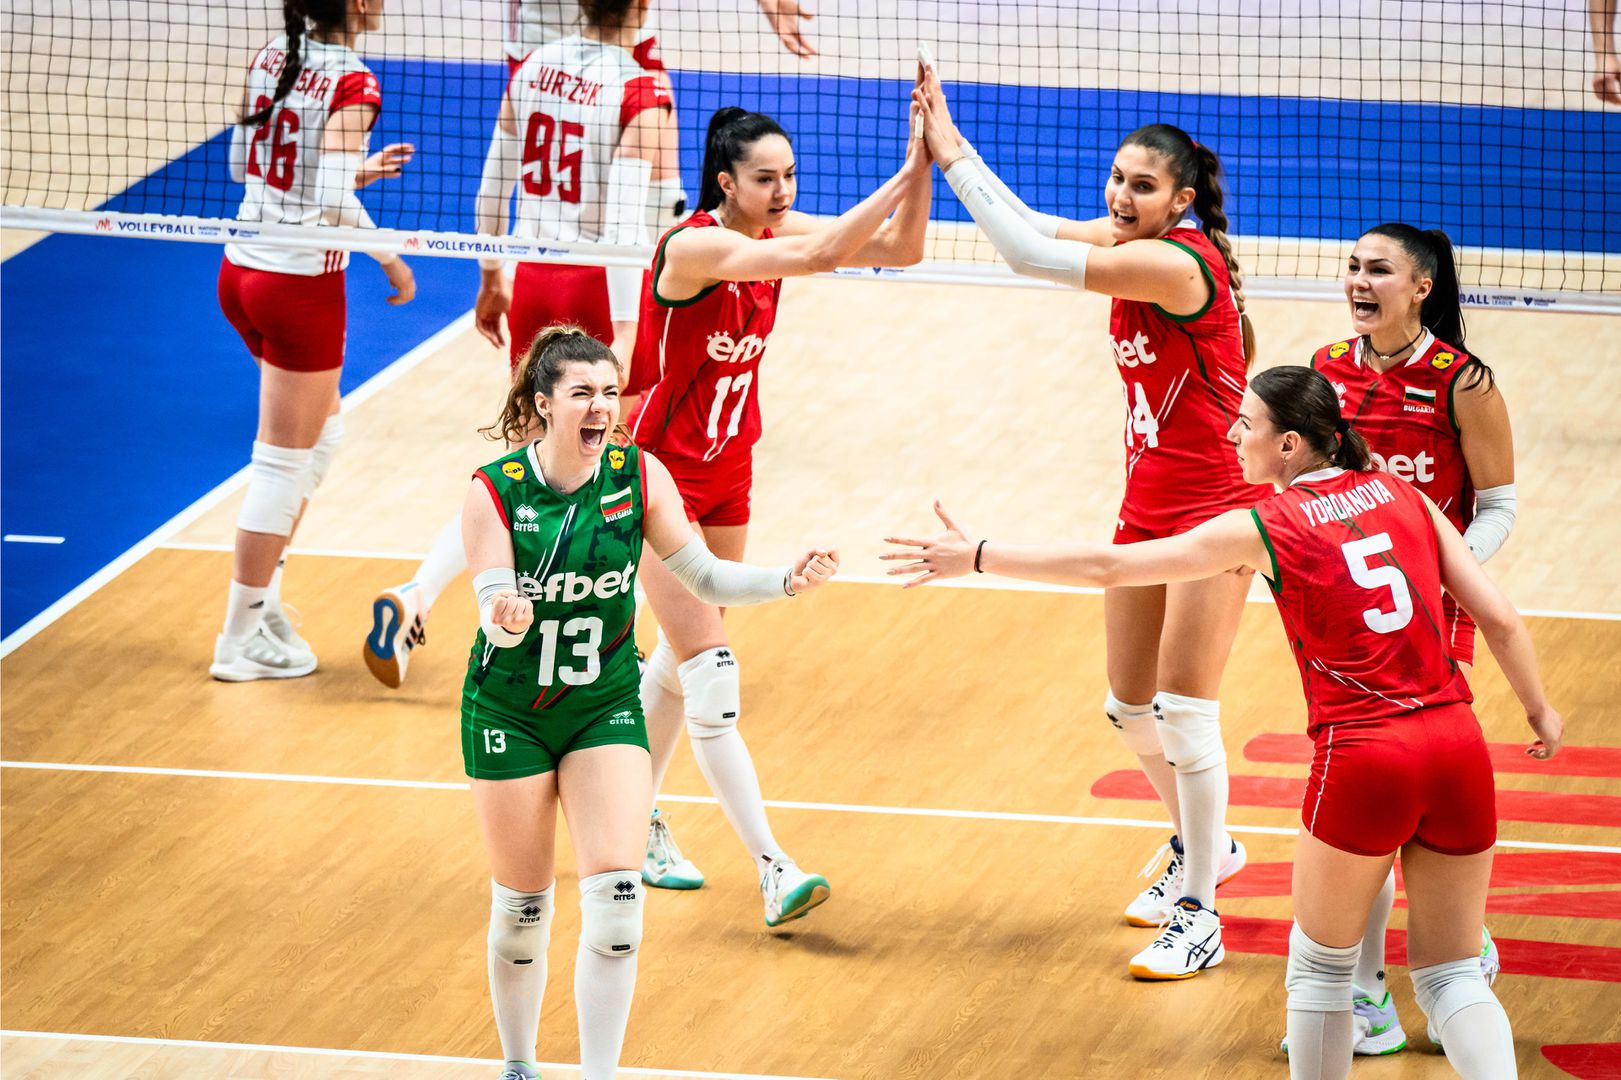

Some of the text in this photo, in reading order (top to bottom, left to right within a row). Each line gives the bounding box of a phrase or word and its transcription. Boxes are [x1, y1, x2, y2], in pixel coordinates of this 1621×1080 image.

[529, 65, 603, 106] JURCZYK
[246, 95, 300, 192] 26
[521, 112, 584, 204] 95
[118, 221, 195, 235] VOLLEYBALL
[427, 240, 505, 254] VOLLEYBALL
[706, 370, 753, 439] 17
[1403, 404, 1435, 414] BULGARIA
[605, 508, 634, 524] BULGARIA
[1299, 478, 1395, 527] YORDANOVA
[513, 521, 539, 533] errea
[517, 560, 636, 603] efbet
[1341, 532, 1414, 634] 5
[538, 616, 604, 687] 13
[483, 728, 507, 754] 13
[613, 893, 636, 901] errea
[519, 915, 541, 923] errea
